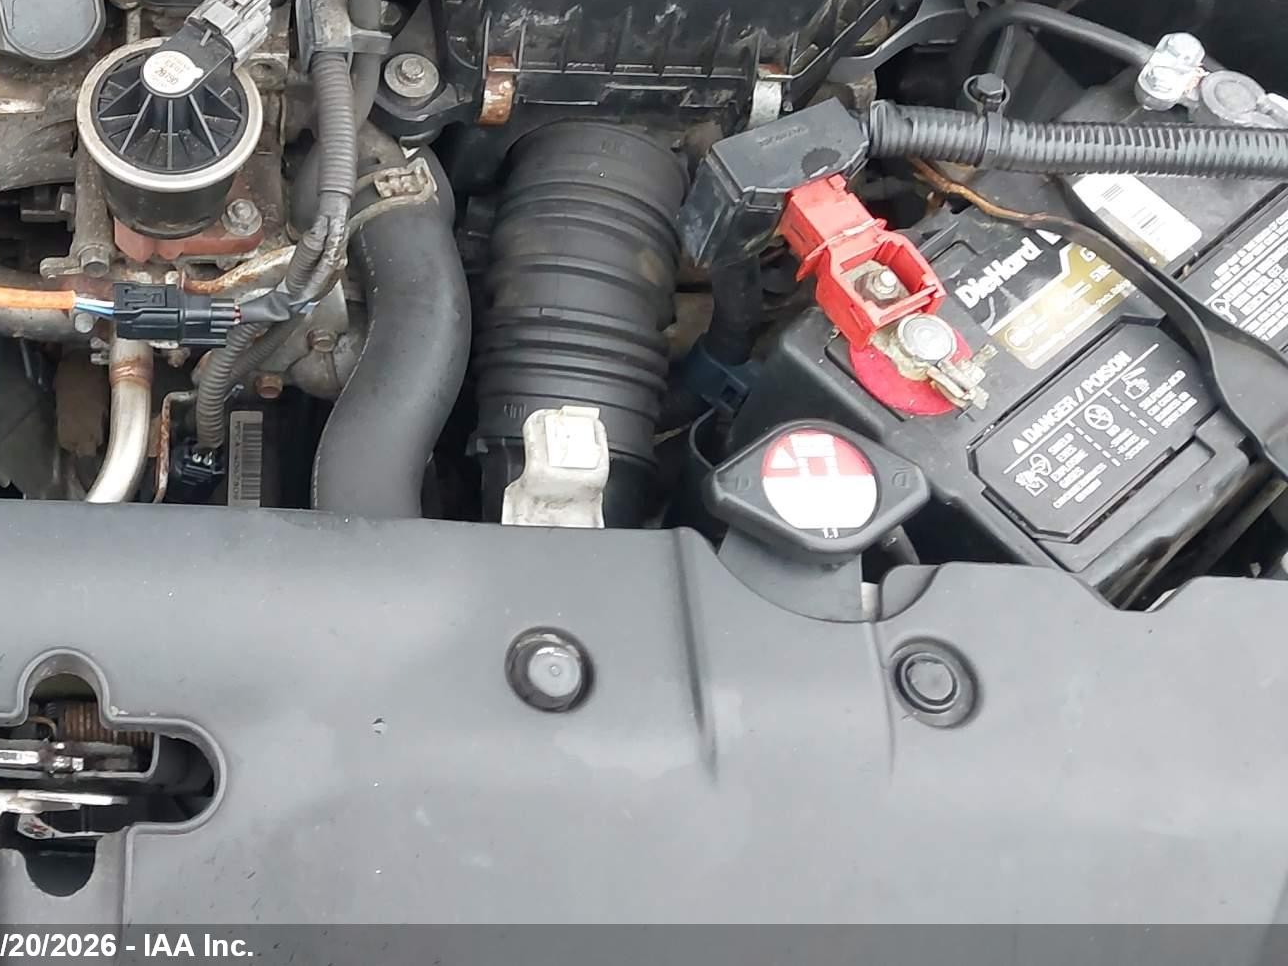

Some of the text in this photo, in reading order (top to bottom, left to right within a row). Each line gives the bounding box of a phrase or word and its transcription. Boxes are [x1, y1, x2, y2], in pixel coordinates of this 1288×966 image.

[954, 236, 1044, 309] DieHard
[1021, 395, 1079, 443] DANGER
[1081, 350, 1132, 394] POISON
